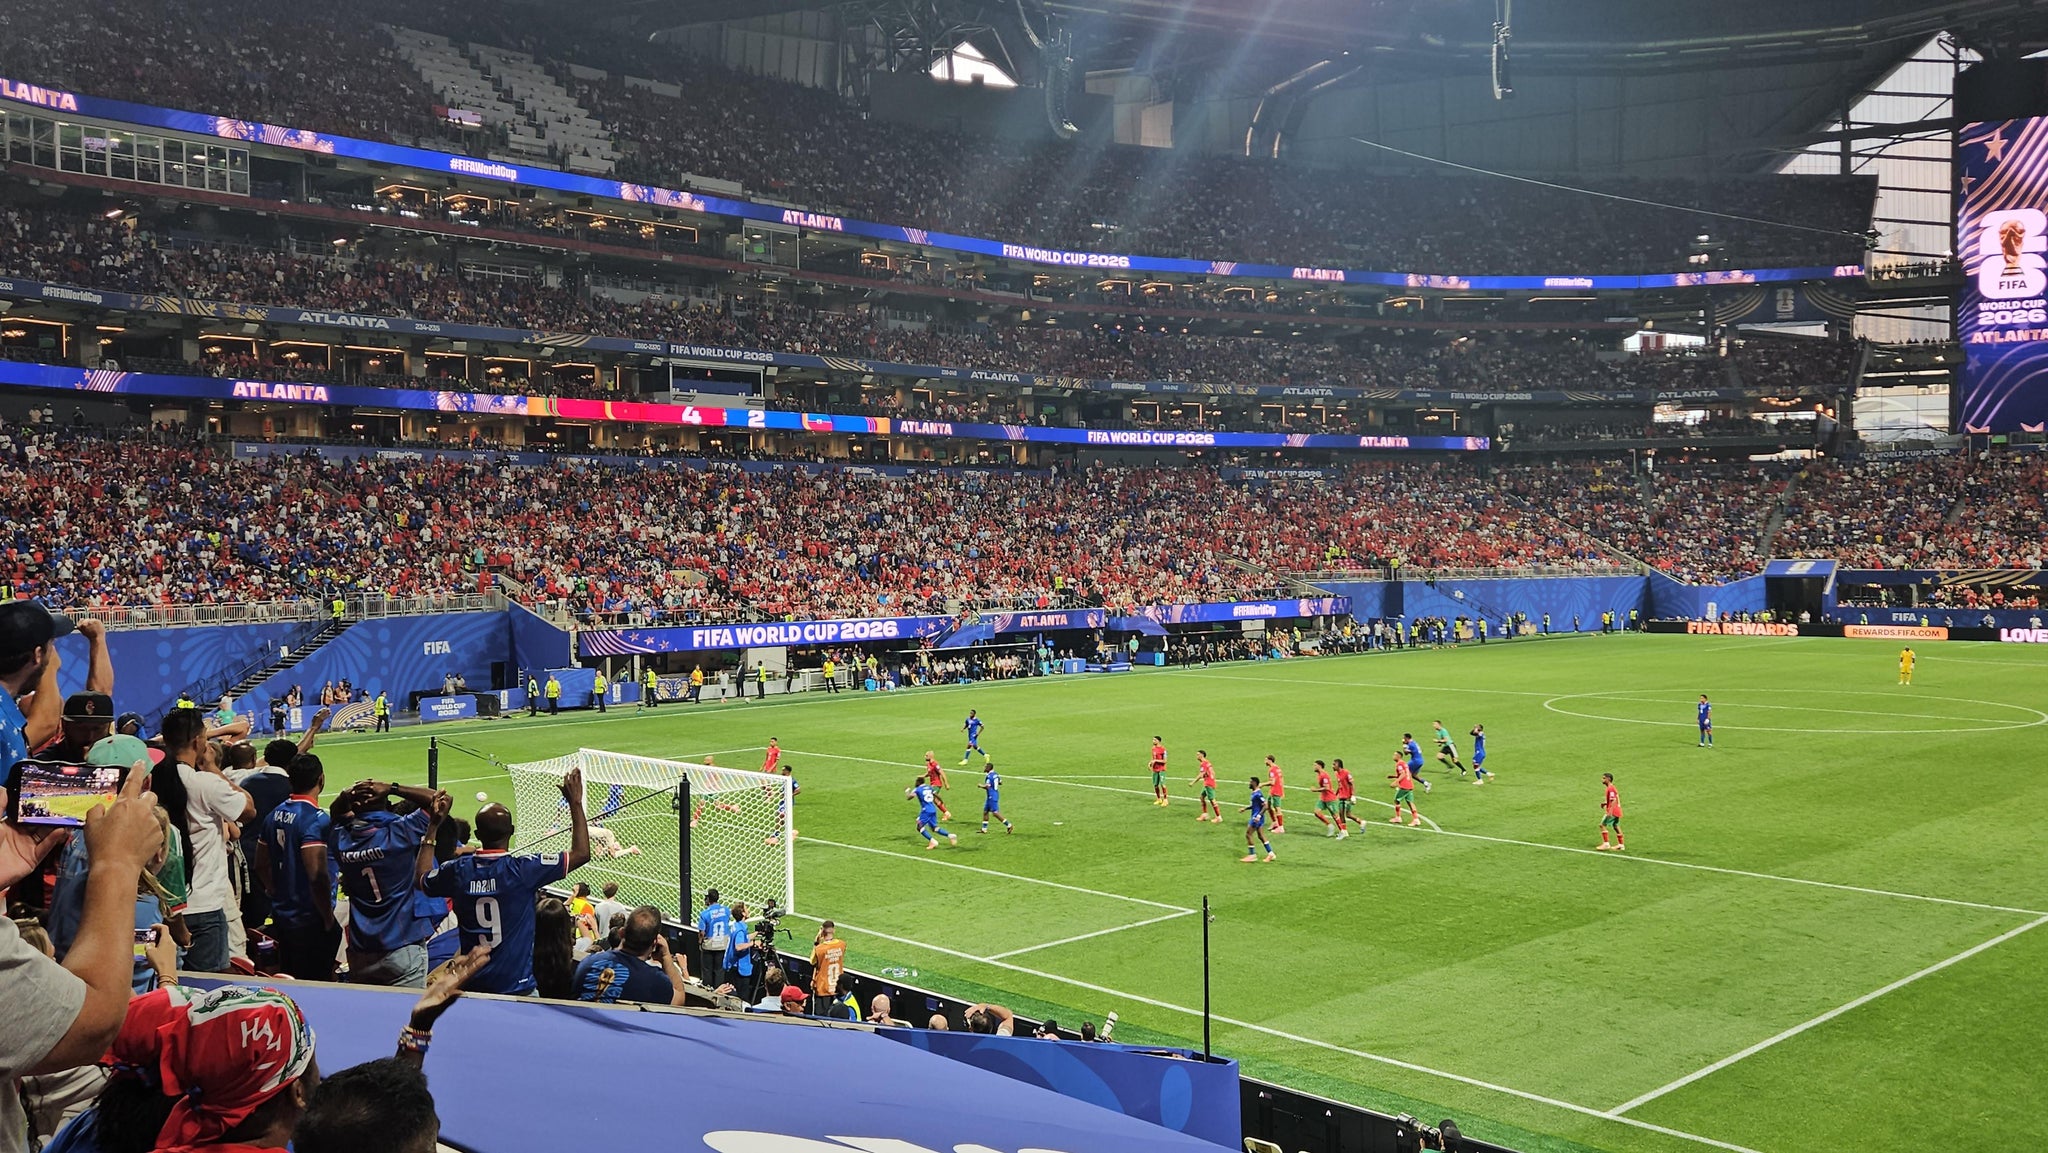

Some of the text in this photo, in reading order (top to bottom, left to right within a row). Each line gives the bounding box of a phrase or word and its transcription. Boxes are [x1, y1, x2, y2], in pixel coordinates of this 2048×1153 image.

[450, 158, 516, 180] #FIFAWorldCup
[783, 210, 842, 231] ATLANTA
[1003, 244, 1130, 267] FIFA WORLD CUP 2026
[1293, 267, 1344, 281] ATLANTA
[1999, 280, 2027, 290] FIFA
[42, 286, 102, 305] #FIFAWorldCup
[1979, 299, 2047, 311] WORLD CUP
[298, 311, 390, 329] ATLANTA
[1978, 309, 2047, 325] 2026
[1971, 328, 2048, 344] ATLANTA
[670, 344, 774, 361] FIFA WORLD CUP 2026
[970, 371, 1019, 382] ATLANTA
[233, 381, 328, 401] ATLANTA
[1283, 388, 1333, 396] ATLANTA
[1657, 390, 1719, 399] ATLANTA
[682, 406, 765, 428] 4 2
[900, 420, 953, 435] ATLANTA
[1088, 431, 1215, 445] FIFA WORLD CUP 2026
[1360, 436, 1409, 448] ATLANTA
[1020, 614, 1068, 627] ATLANTA
[1892, 612, 1917, 622] FIFA
[692, 620, 898, 648] FIFA WORLD CUP 2026
[1687, 621, 1799, 636] FIFA REWARDS
[1852, 627, 1941, 637] REWARDS.FIFA.COM
[2000, 628, 2048, 643] LOVE
[423, 641, 451, 655] FIFA
[431, 703, 454, 711] WORLD
[438, 709, 460, 717] 2026
[361, 867, 382, 903] 1
[475, 896, 503, 949] 9
